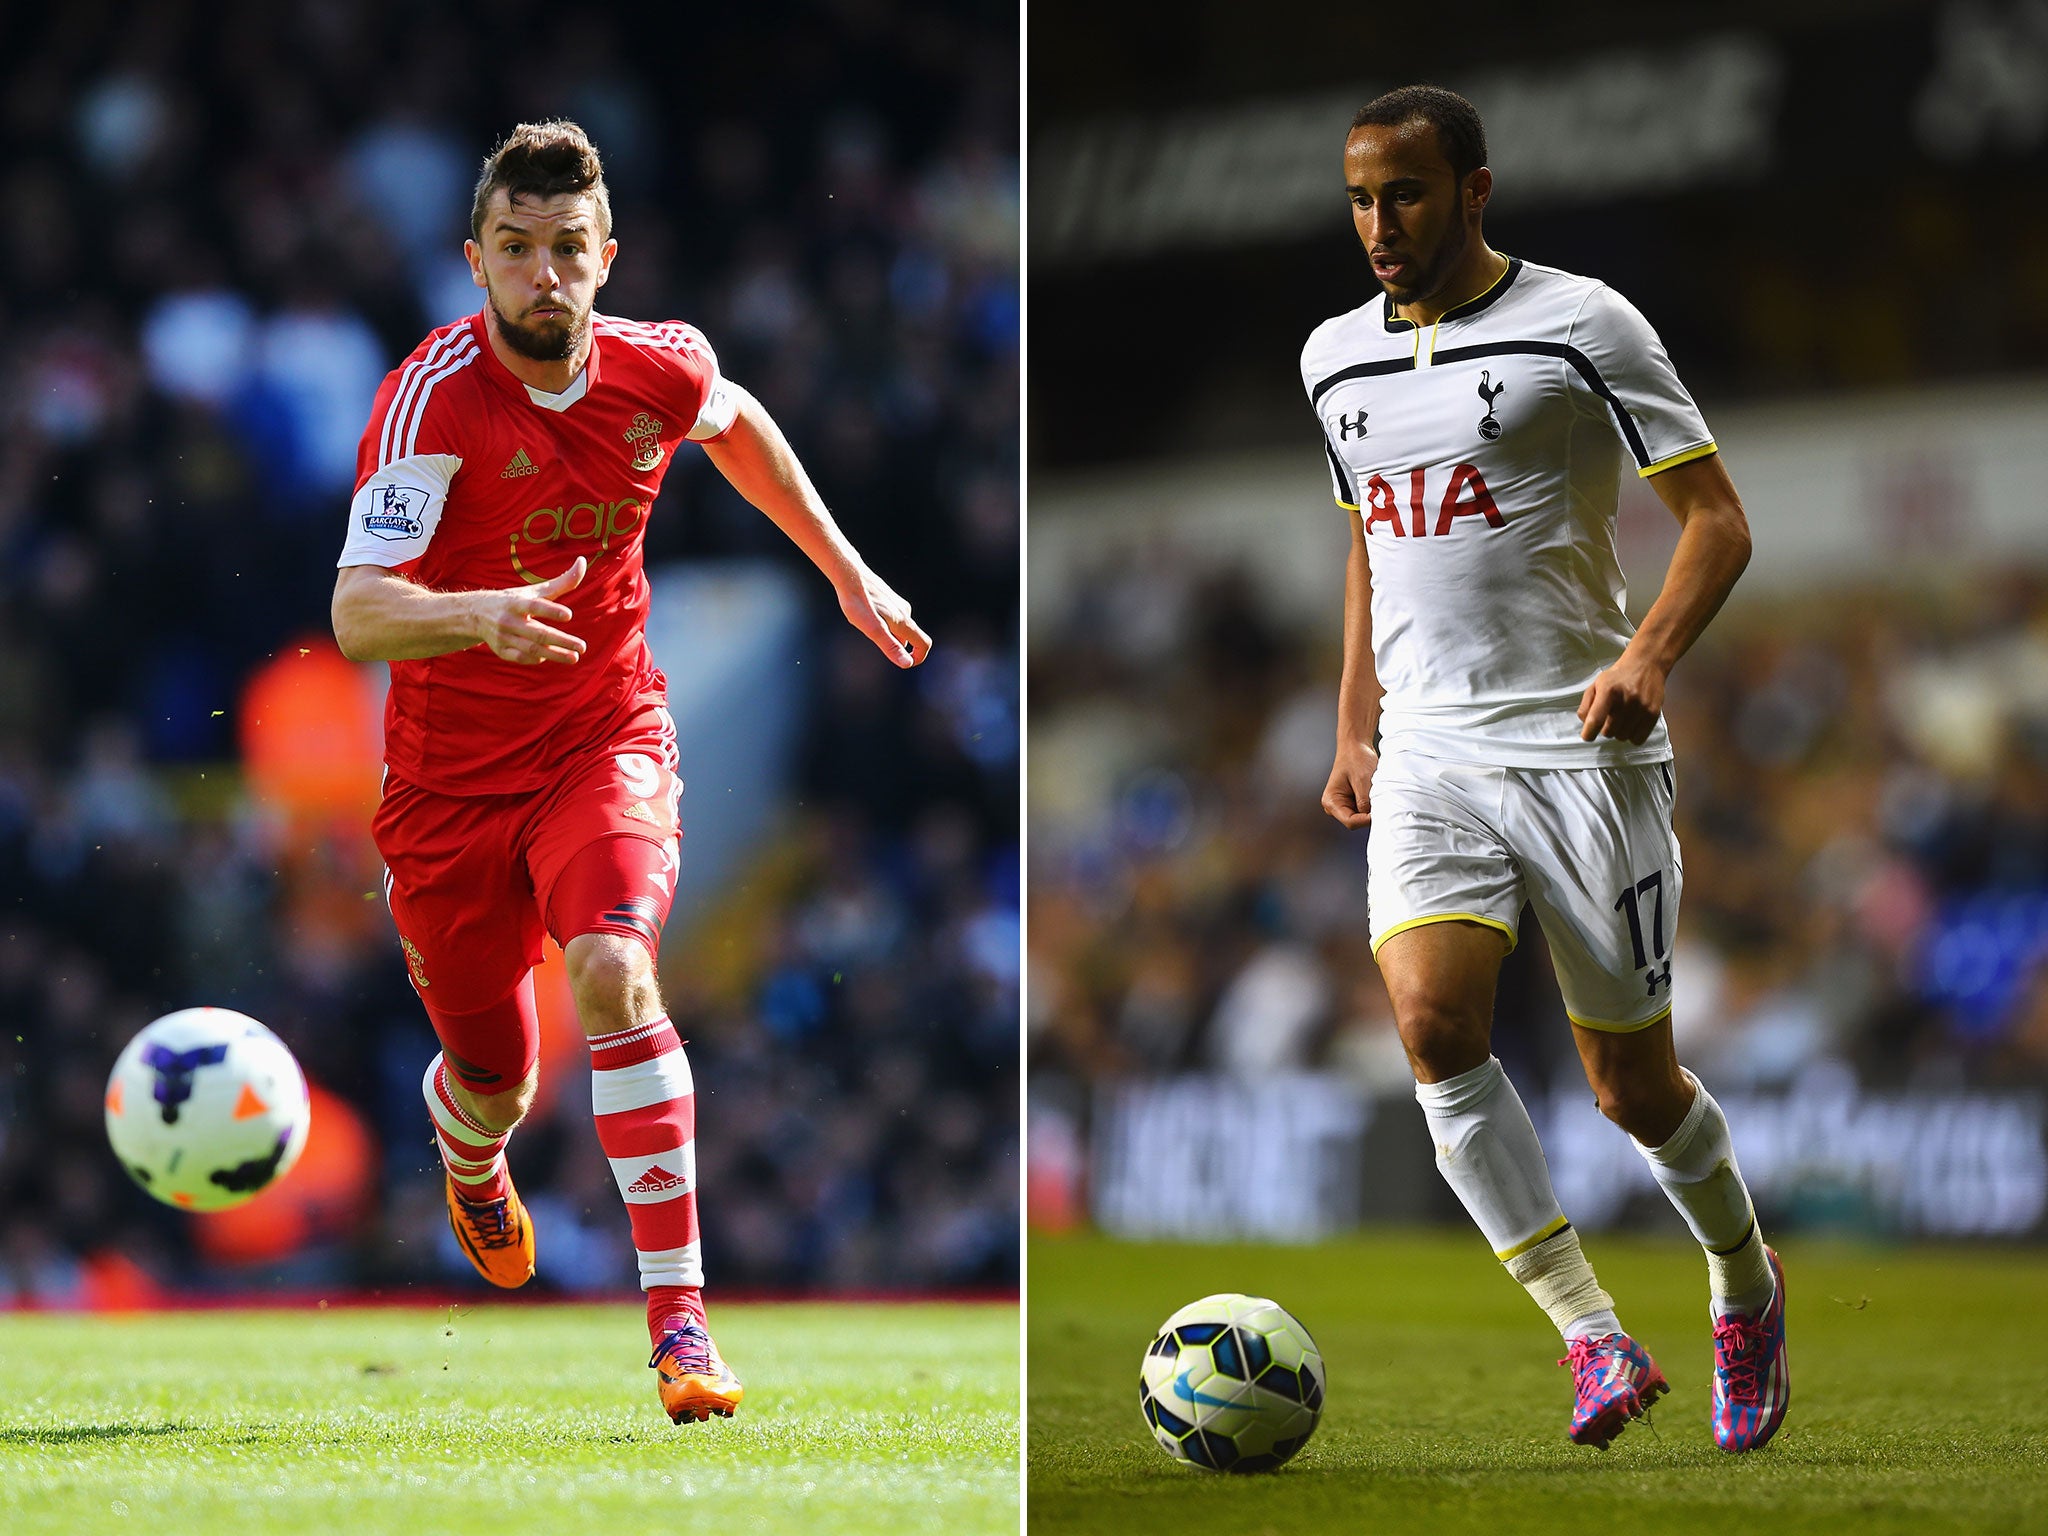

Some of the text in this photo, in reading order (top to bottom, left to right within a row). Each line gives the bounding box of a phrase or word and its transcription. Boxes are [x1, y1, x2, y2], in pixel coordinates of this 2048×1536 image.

[500, 465, 540, 479] adidas
[1366, 464, 1507, 538] AIA
[370, 517, 408, 527] BARCLAYS
[615, 753, 660, 798] 9
[1614, 870, 1665, 970] 17
[628, 1175, 687, 1194] adidas
